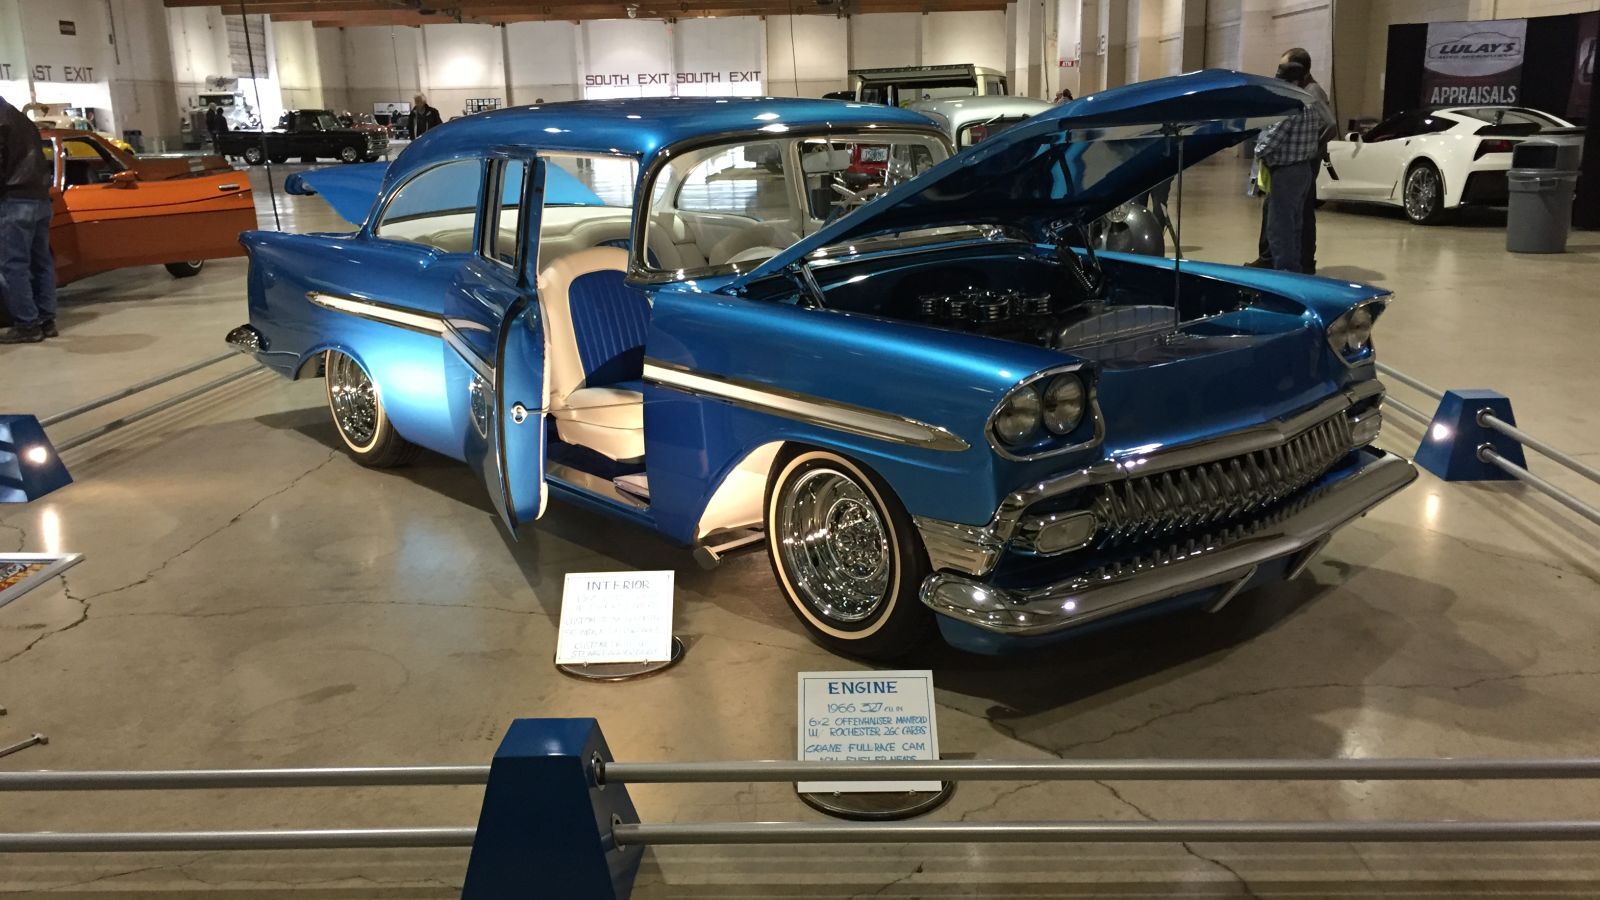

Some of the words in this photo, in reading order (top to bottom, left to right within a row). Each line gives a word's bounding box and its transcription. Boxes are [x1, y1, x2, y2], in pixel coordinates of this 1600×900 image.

[1439, 42, 1516, 54] LULAY'S
[63, 66, 93, 81] EXIT
[585, 74, 630, 86] SOUTH
[637, 73, 670, 84] EXIT
[676, 72, 721, 84] SOUTH
[729, 71, 761, 83] EXIT
[1430, 85, 1517, 104] APPRAISALS
[828, 681, 898, 695] ENGINE
[827, 703, 856, 713] 1966
[859, 702, 883, 713] 327
[829, 726, 880, 737] ROCHESTER
[901, 742, 926, 751] CAM
